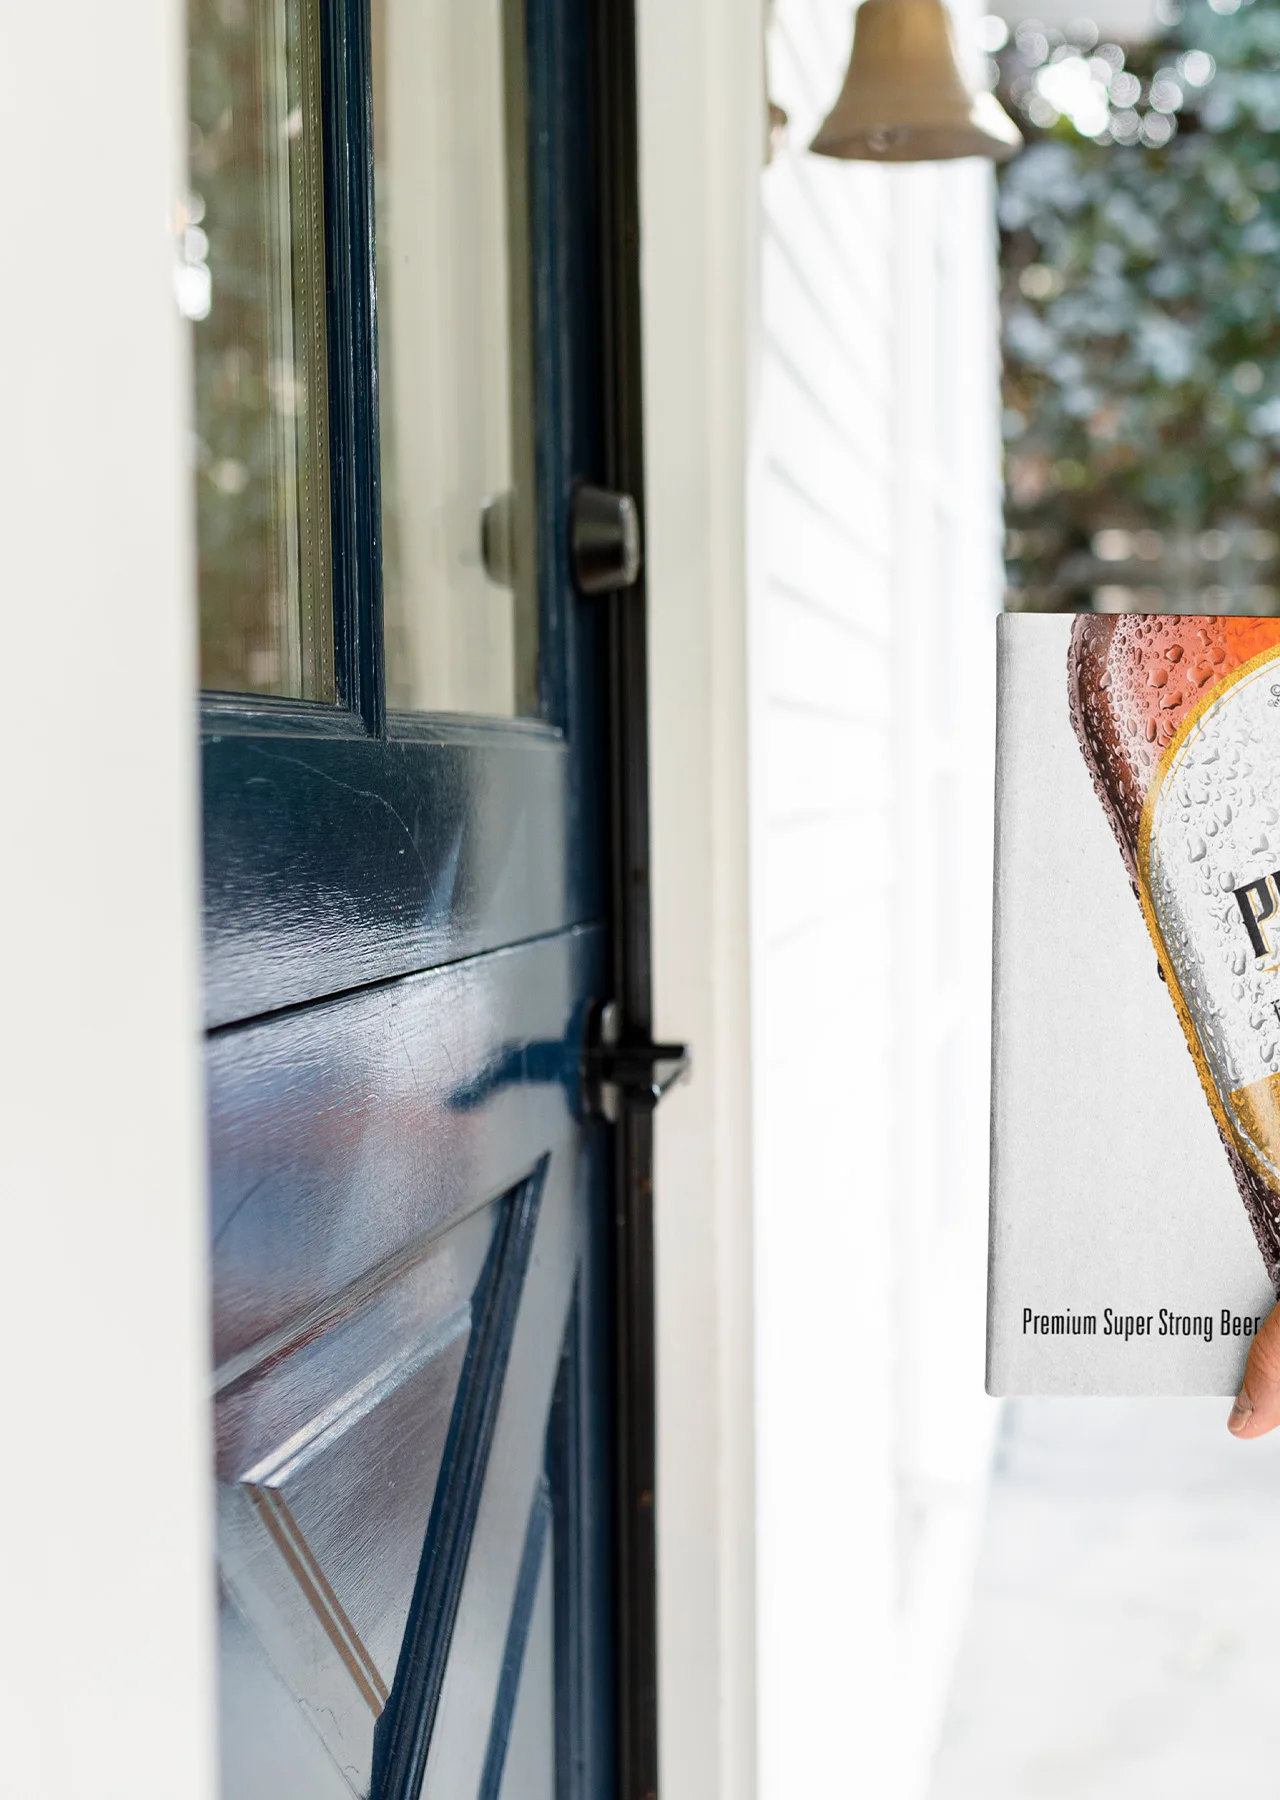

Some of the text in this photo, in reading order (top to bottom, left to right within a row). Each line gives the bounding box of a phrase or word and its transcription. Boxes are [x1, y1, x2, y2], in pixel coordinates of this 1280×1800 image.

[1023, 1307, 1261, 1342] Premium Super Strong Beer
